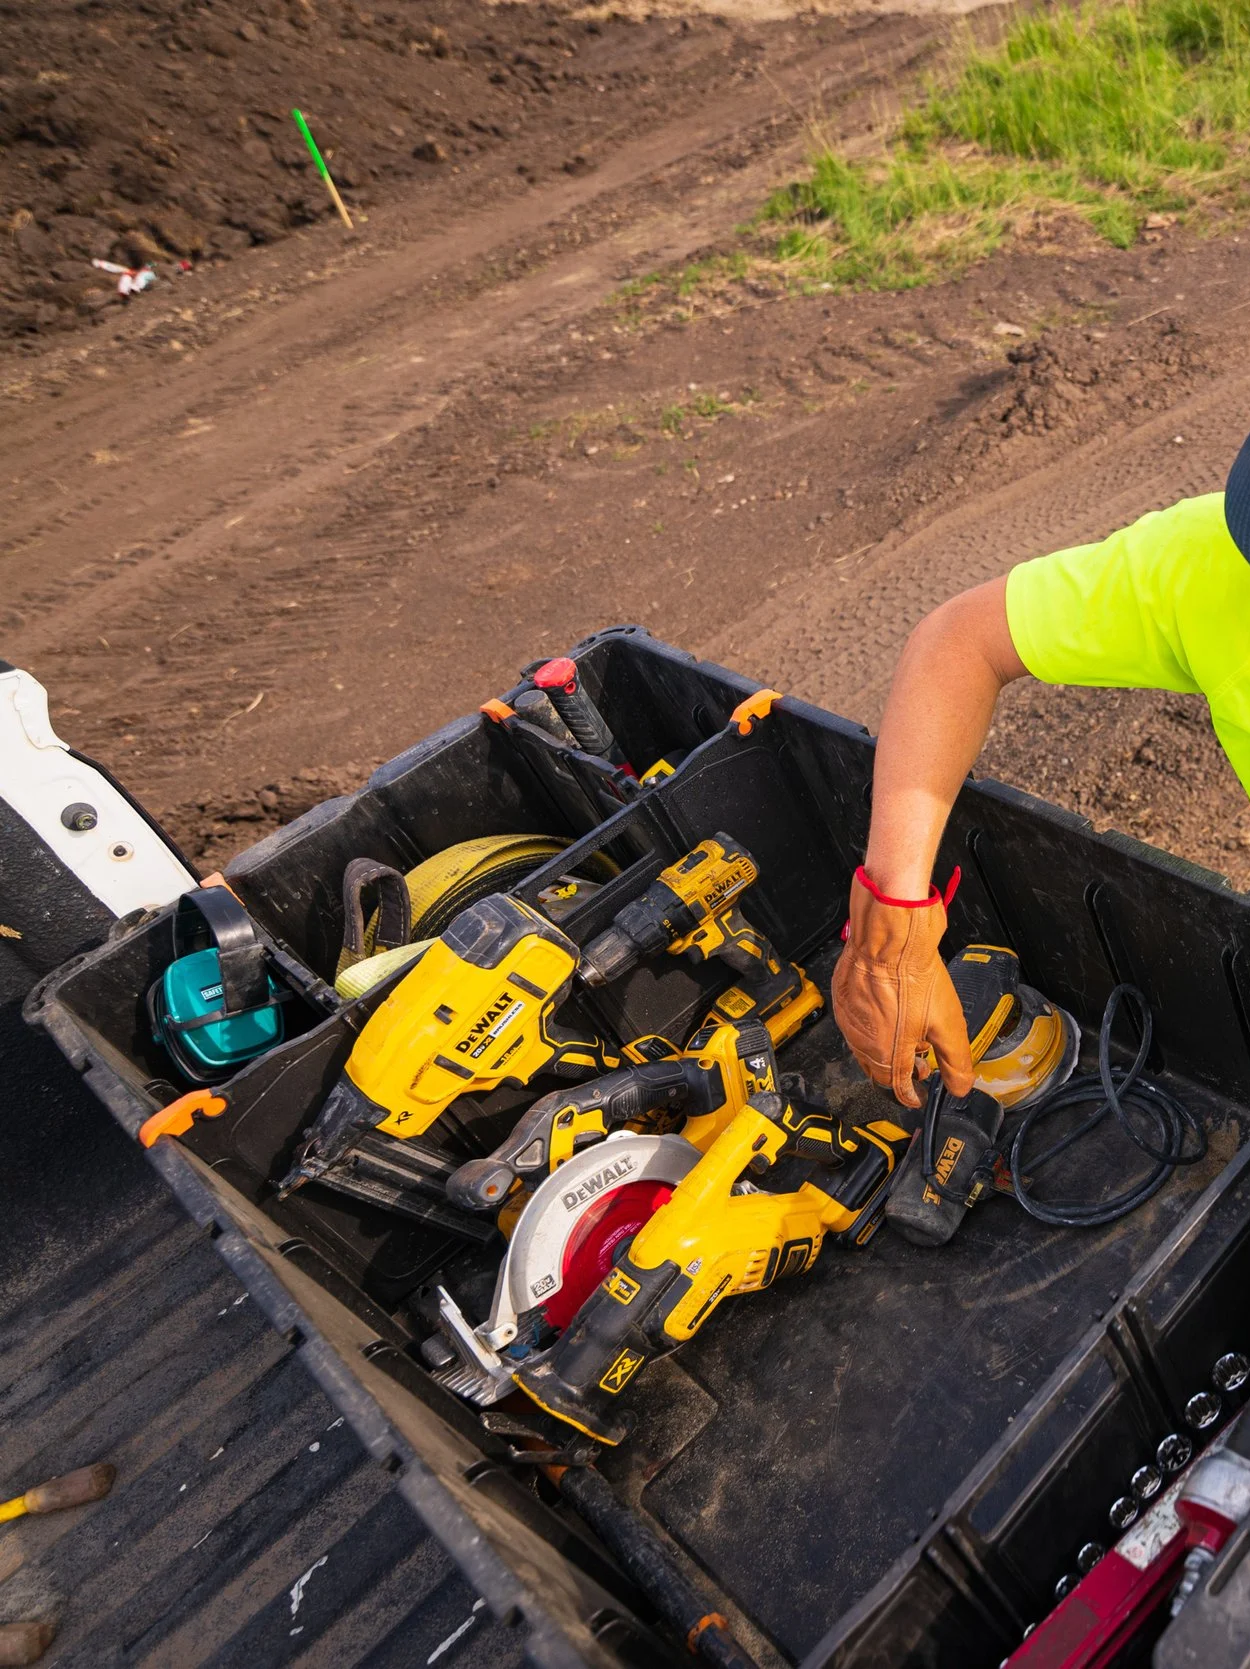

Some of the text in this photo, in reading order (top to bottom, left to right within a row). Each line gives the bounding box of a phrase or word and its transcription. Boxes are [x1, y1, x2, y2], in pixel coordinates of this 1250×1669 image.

[455, 992, 514, 1054] DEWALT
[395, 1111, 413, 1125] XR
[560, 1156, 634, 1210] DEWALT
[923, 1136, 963, 1205] DEWT
[608, 1357, 637, 1386] XR
